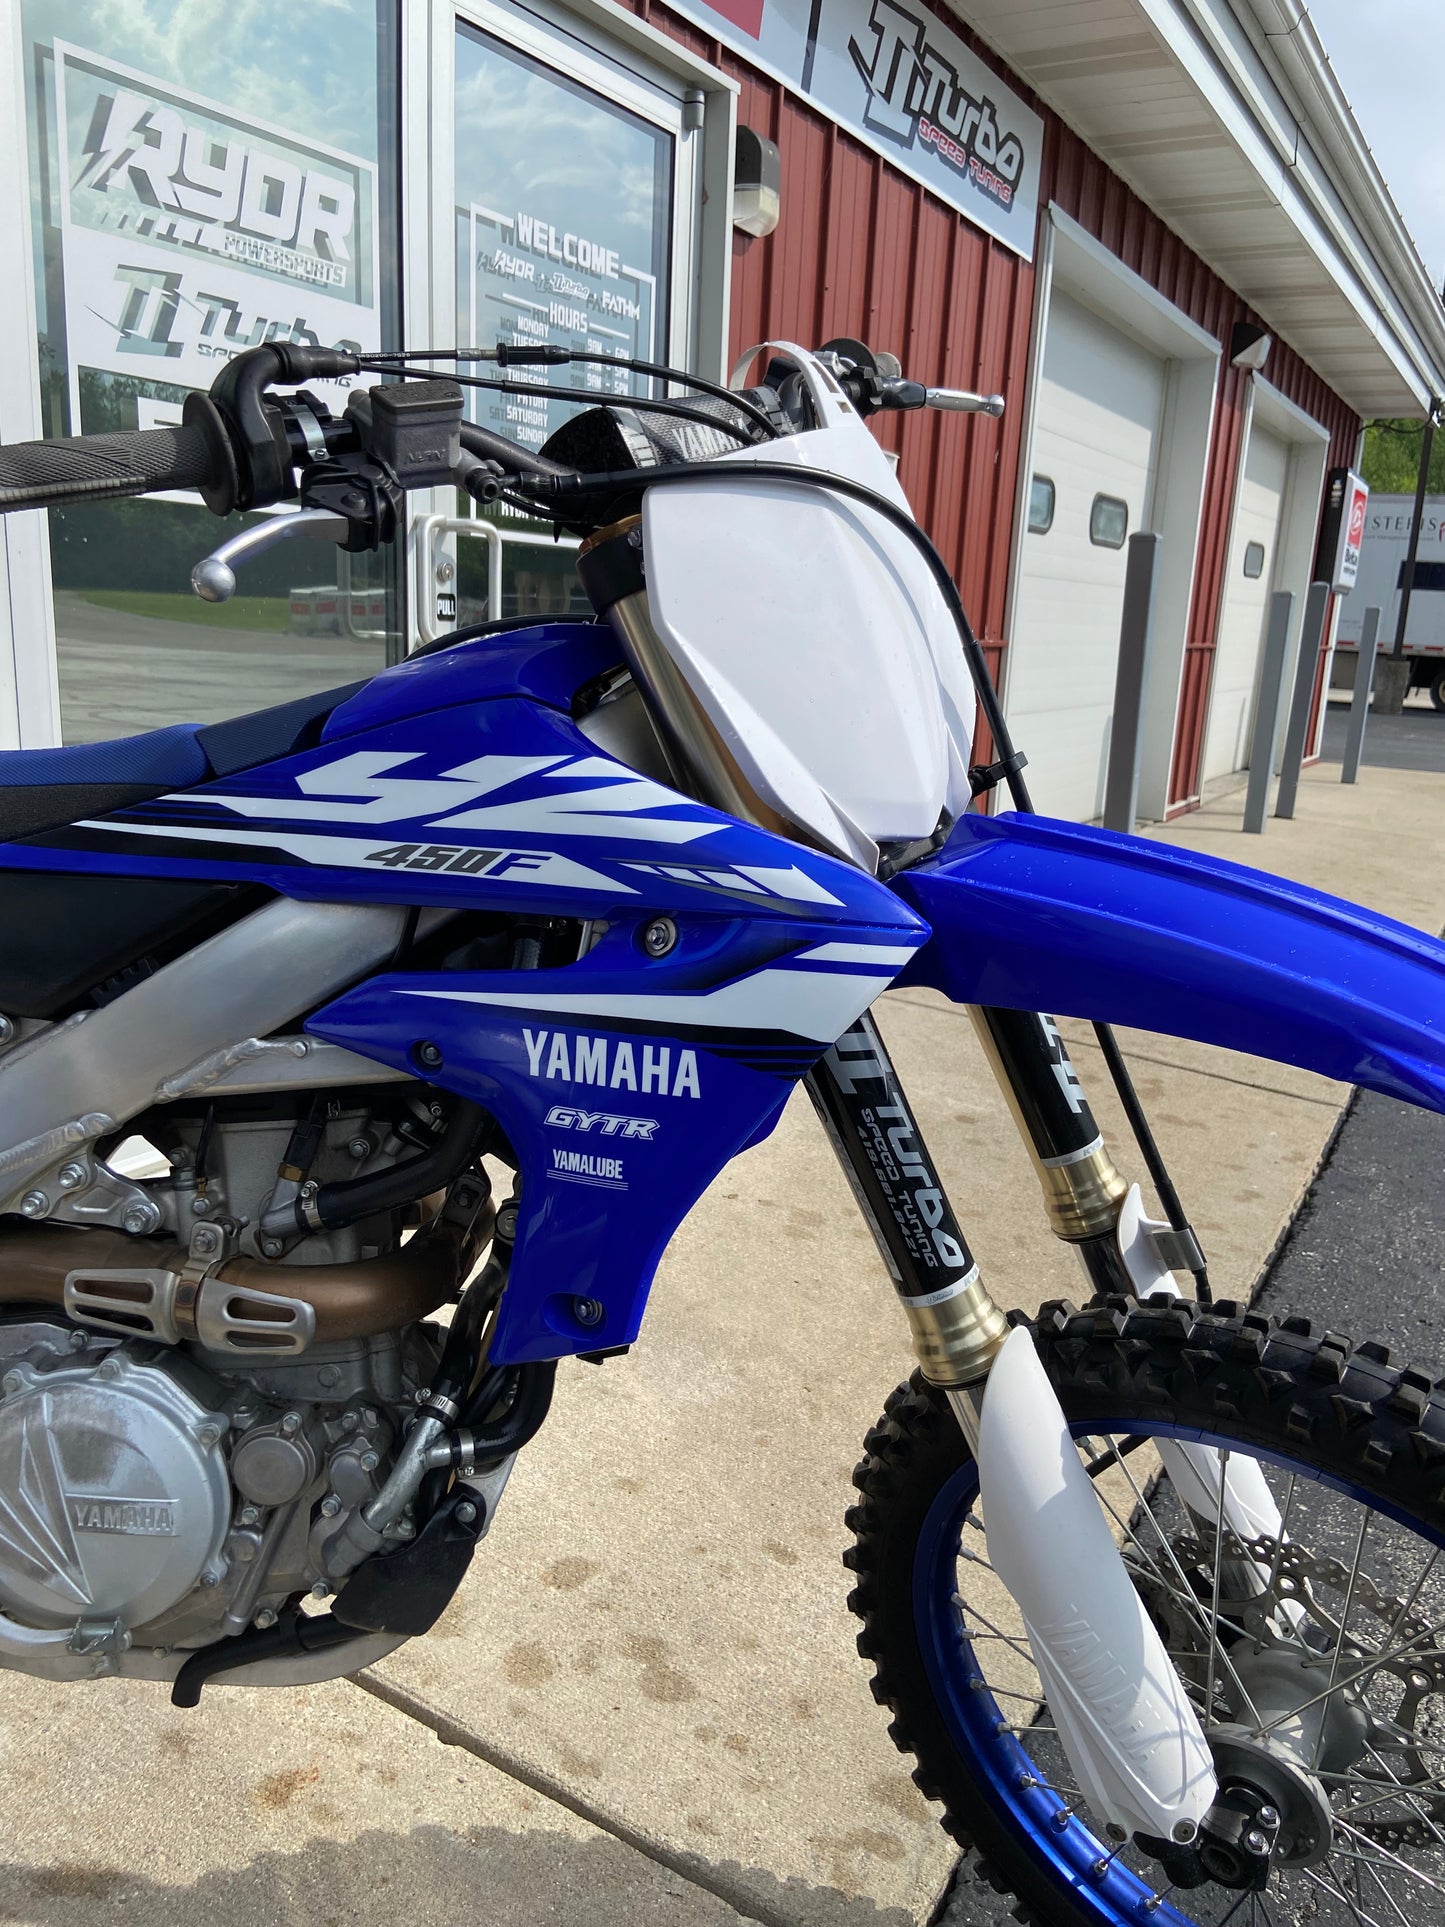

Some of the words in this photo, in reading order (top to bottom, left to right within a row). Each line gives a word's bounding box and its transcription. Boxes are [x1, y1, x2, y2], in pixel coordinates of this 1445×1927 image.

[921, 51, 1023, 183] Turbo
[88, 89, 355, 261] RYDR
[224, 233, 345, 285] POWERSPORTS
[517, 212, 620, 279] WELCOME
[550, 302, 588, 333] HOURS
[602, 290, 641, 321] FATHM
[517, 316, 549, 338] MONDAY
[506, 405, 548, 428] SATURDAY
[517, 426, 548, 444] SUNDAY
[437, 599, 456, 616] PULL
[362, 843, 553, 876] 450F
[522, 1028, 701, 1099] YAMAHA
[544, 1105, 660, 1140] GYTR
[552, 1148, 624, 1180] YAMALUBE
[875, 1091, 965, 1268] Turbo
[898, 1189, 939, 1268] TUNING
[74, 1503, 174, 1531] YAMAHA
[1039, 1603, 1173, 1776] YAMAHA
